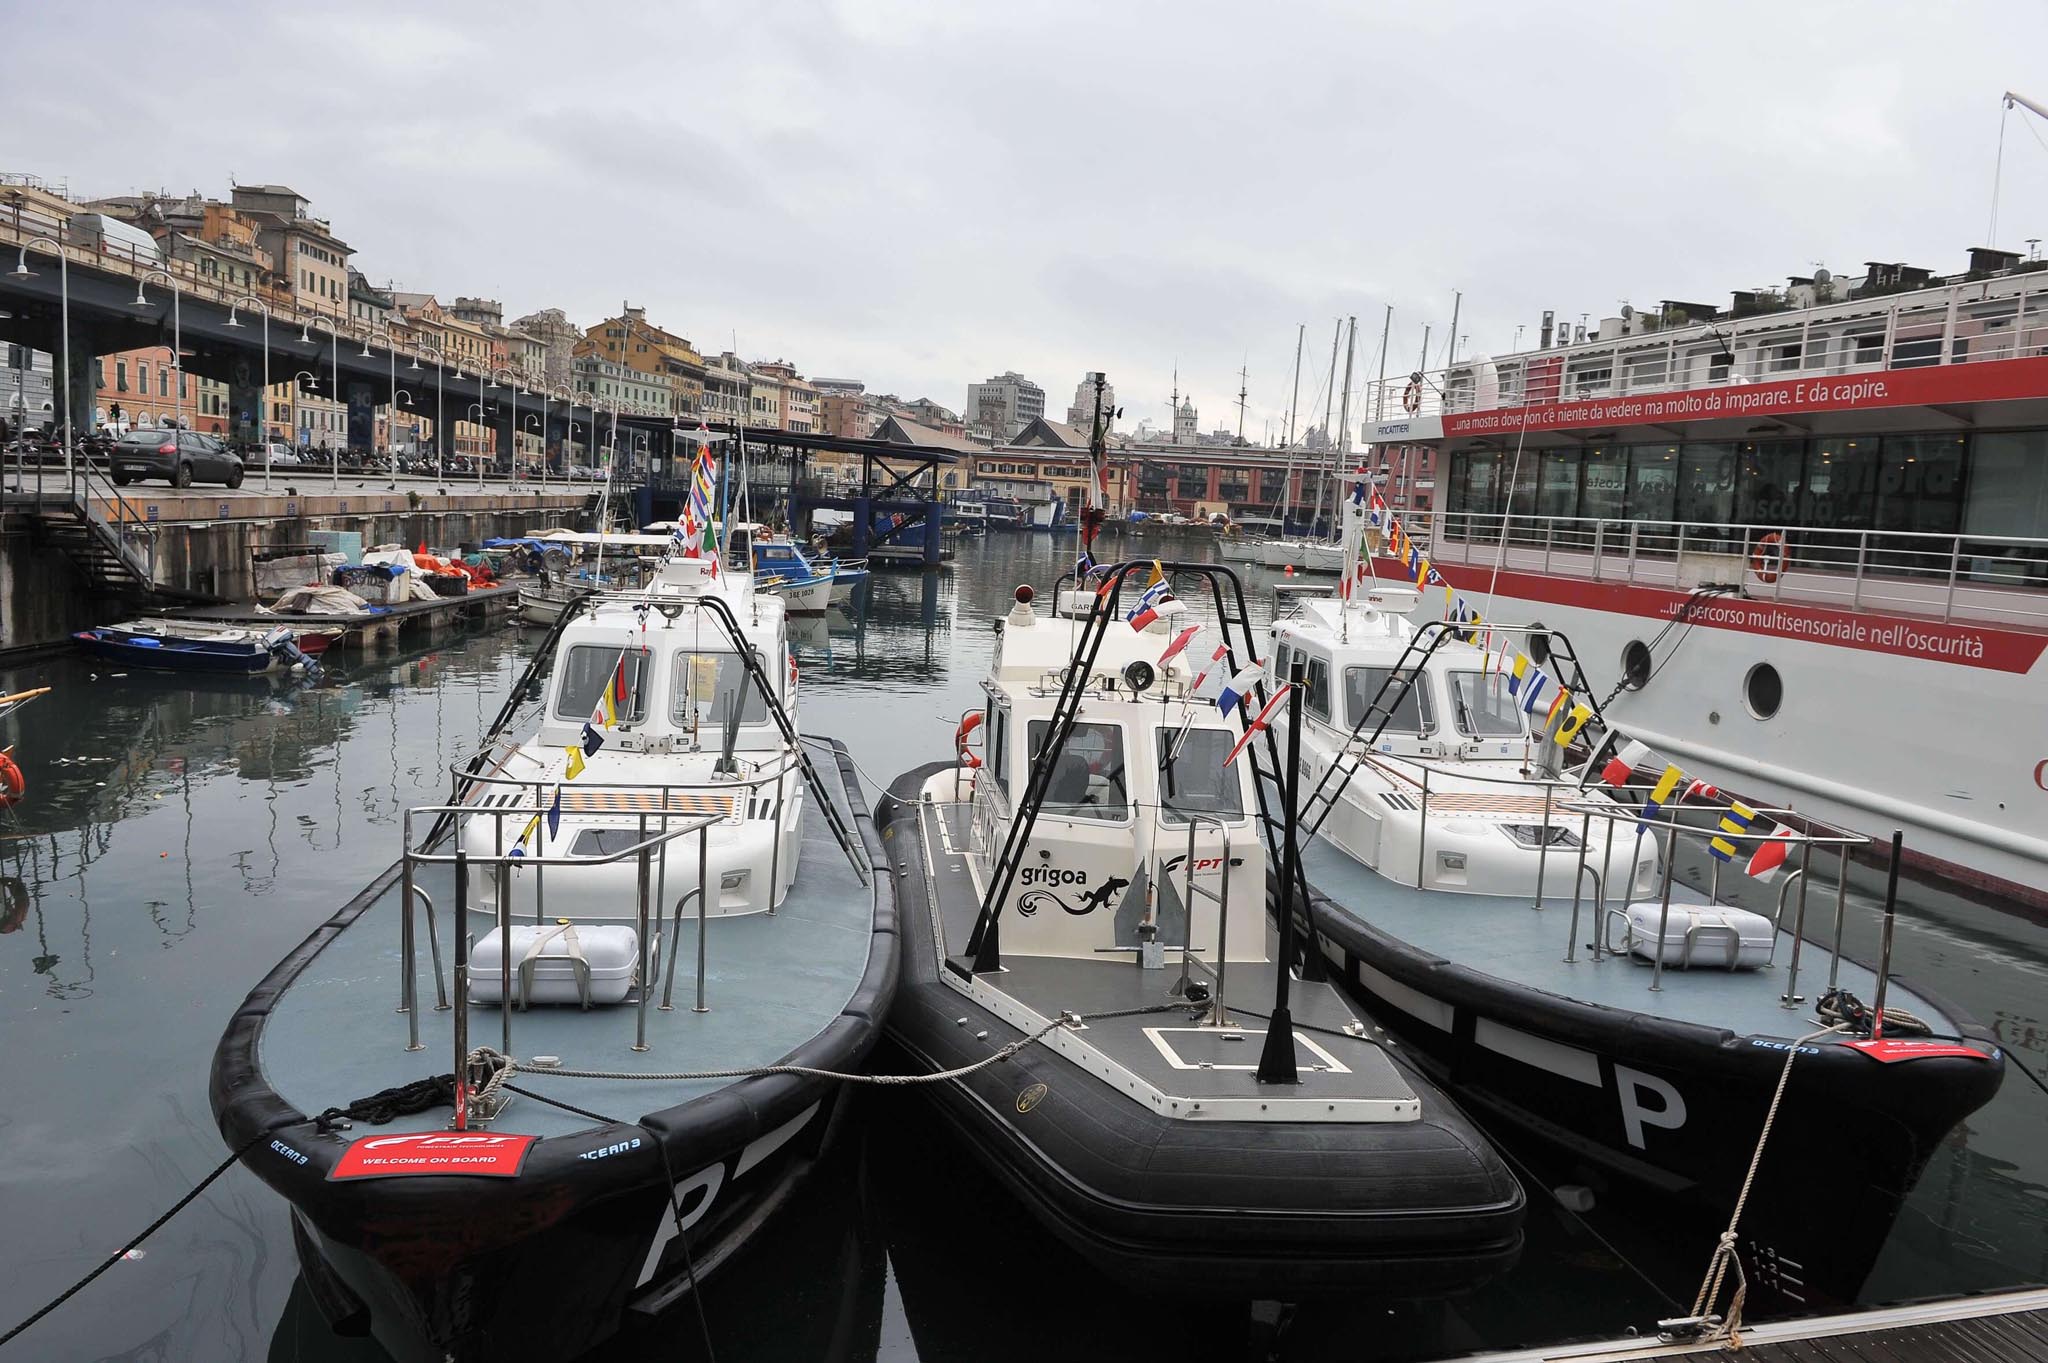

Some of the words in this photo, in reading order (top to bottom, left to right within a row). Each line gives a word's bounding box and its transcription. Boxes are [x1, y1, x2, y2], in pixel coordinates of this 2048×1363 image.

[1471, 416, 1499, 430] mostra
[1501, 411, 1522, 427] dove
[1524, 412, 1541, 426] non
[1558, 407, 1589, 422] niente
[1590, 403, 1604, 420] da
[1605, 401, 1642, 419] vedere
[1644, 402, 1663, 416] ma
[1666, 396, 1701, 414] molto
[1705, 394, 1721, 411] da
[1725, 391, 1791, 412] imparare.
[1795, 384, 1806, 403] E
[1809, 382, 1829, 402] da
[1833, 378, 1889, 405] capire.
[1687, 605, 1745, 625] percorso
[1748, 609, 1866, 642] multisensoriale
[1870, 625, 1984, 659] nell'oscurità
[1021, 863, 1088, 888] grîgoa
[1613, 1062, 1688, 1151] P
[362, 1157, 427, 1165] WELCOME
[452, 1156, 497, 1164] BOARD
[420, 1136, 519, 1145] FPT
[634, 1161, 726, 1289] P
